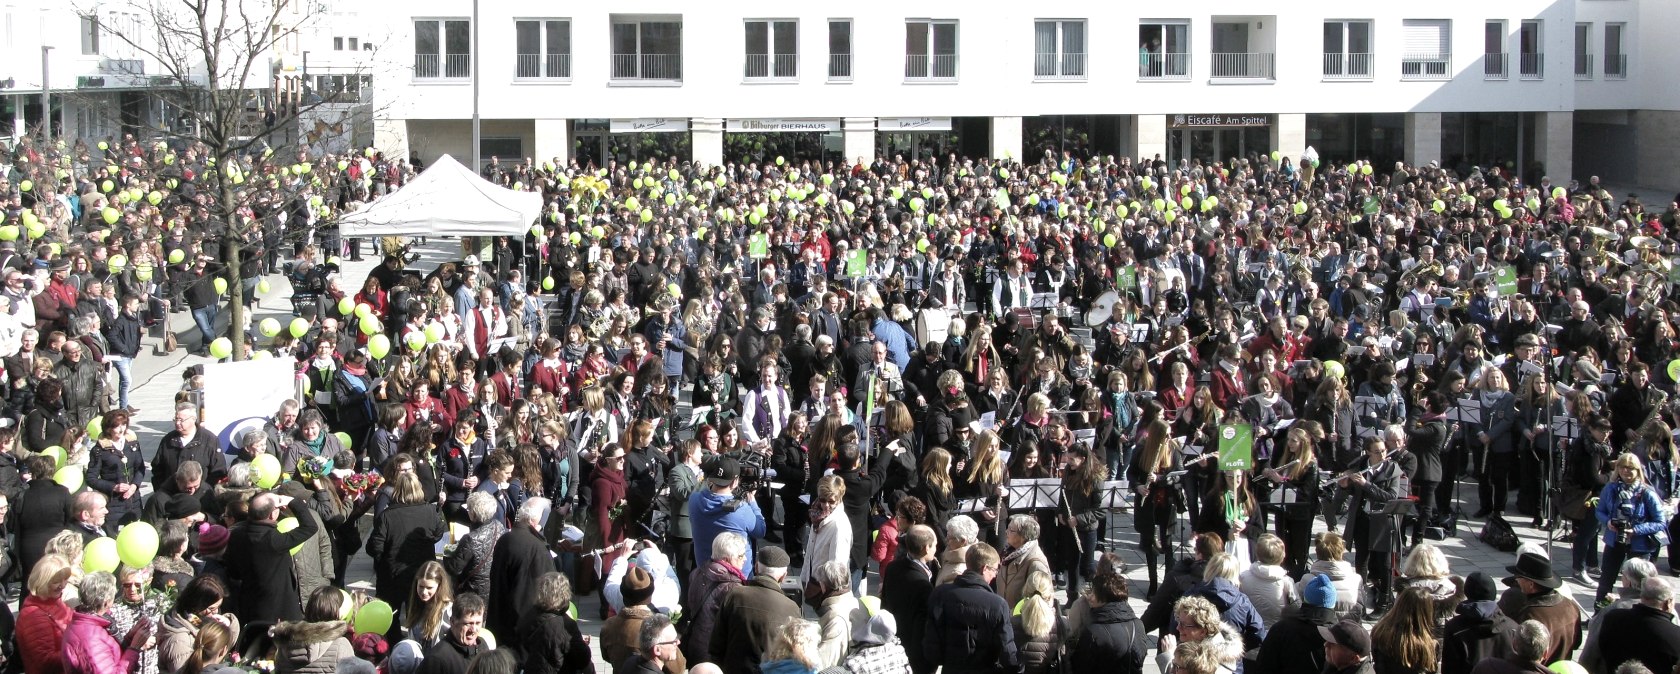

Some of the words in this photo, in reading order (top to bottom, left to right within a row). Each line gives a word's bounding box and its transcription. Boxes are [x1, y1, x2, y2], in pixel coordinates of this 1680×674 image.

[750, 120, 779, 130] Bitburger
[1187, 115, 1221, 125] Eiscafé
[1226, 116, 1239, 124] Am
[1241, 116, 1267, 126] Spittel
